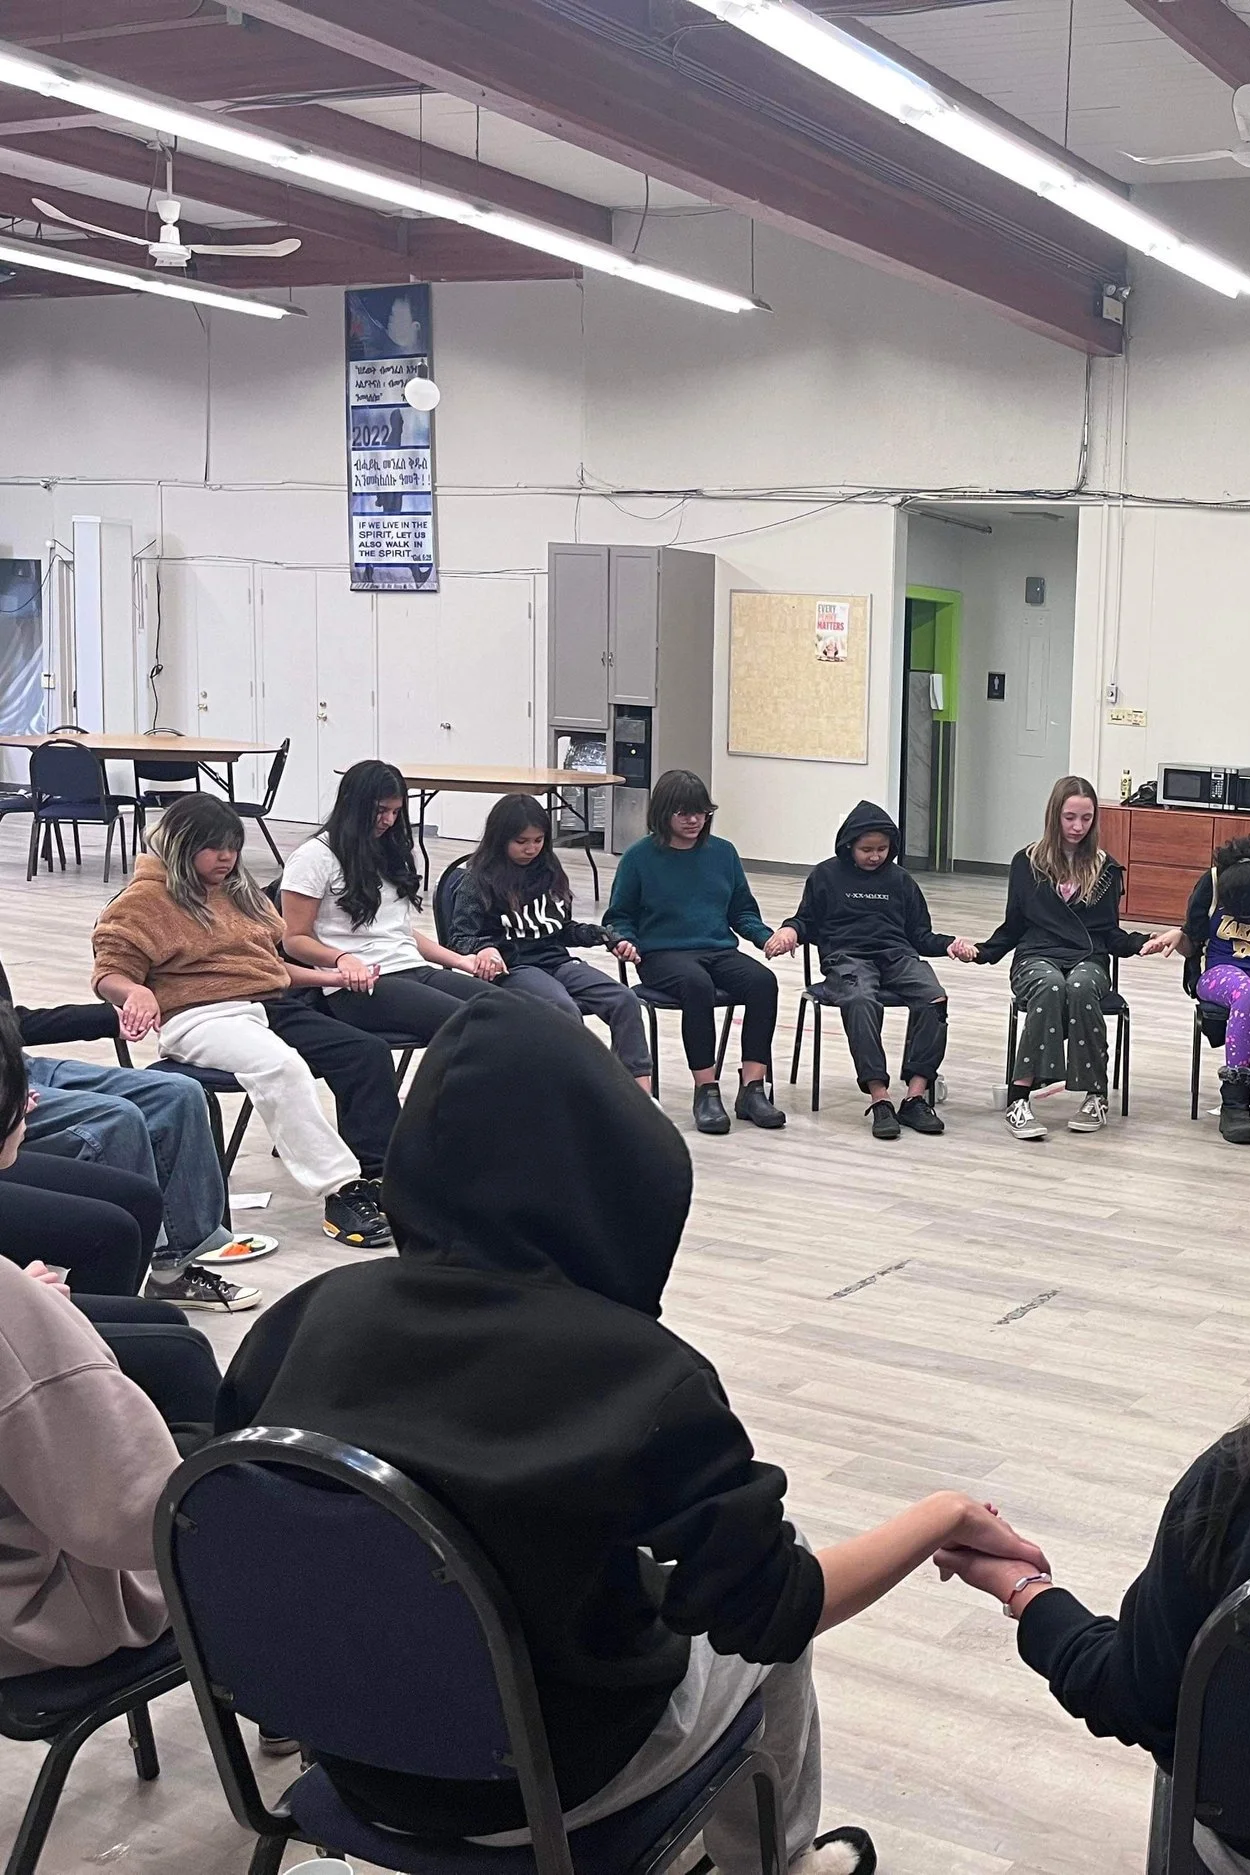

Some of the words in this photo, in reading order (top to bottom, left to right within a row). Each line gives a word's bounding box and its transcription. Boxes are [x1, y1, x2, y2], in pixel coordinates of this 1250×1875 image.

[352, 425, 389, 447] 2022
[412, 521, 428, 529] THE
[359, 531, 393, 539] SPIRIT,
[818, 604, 837, 613] EVERY
[817, 621, 845, 631] MATTERS
